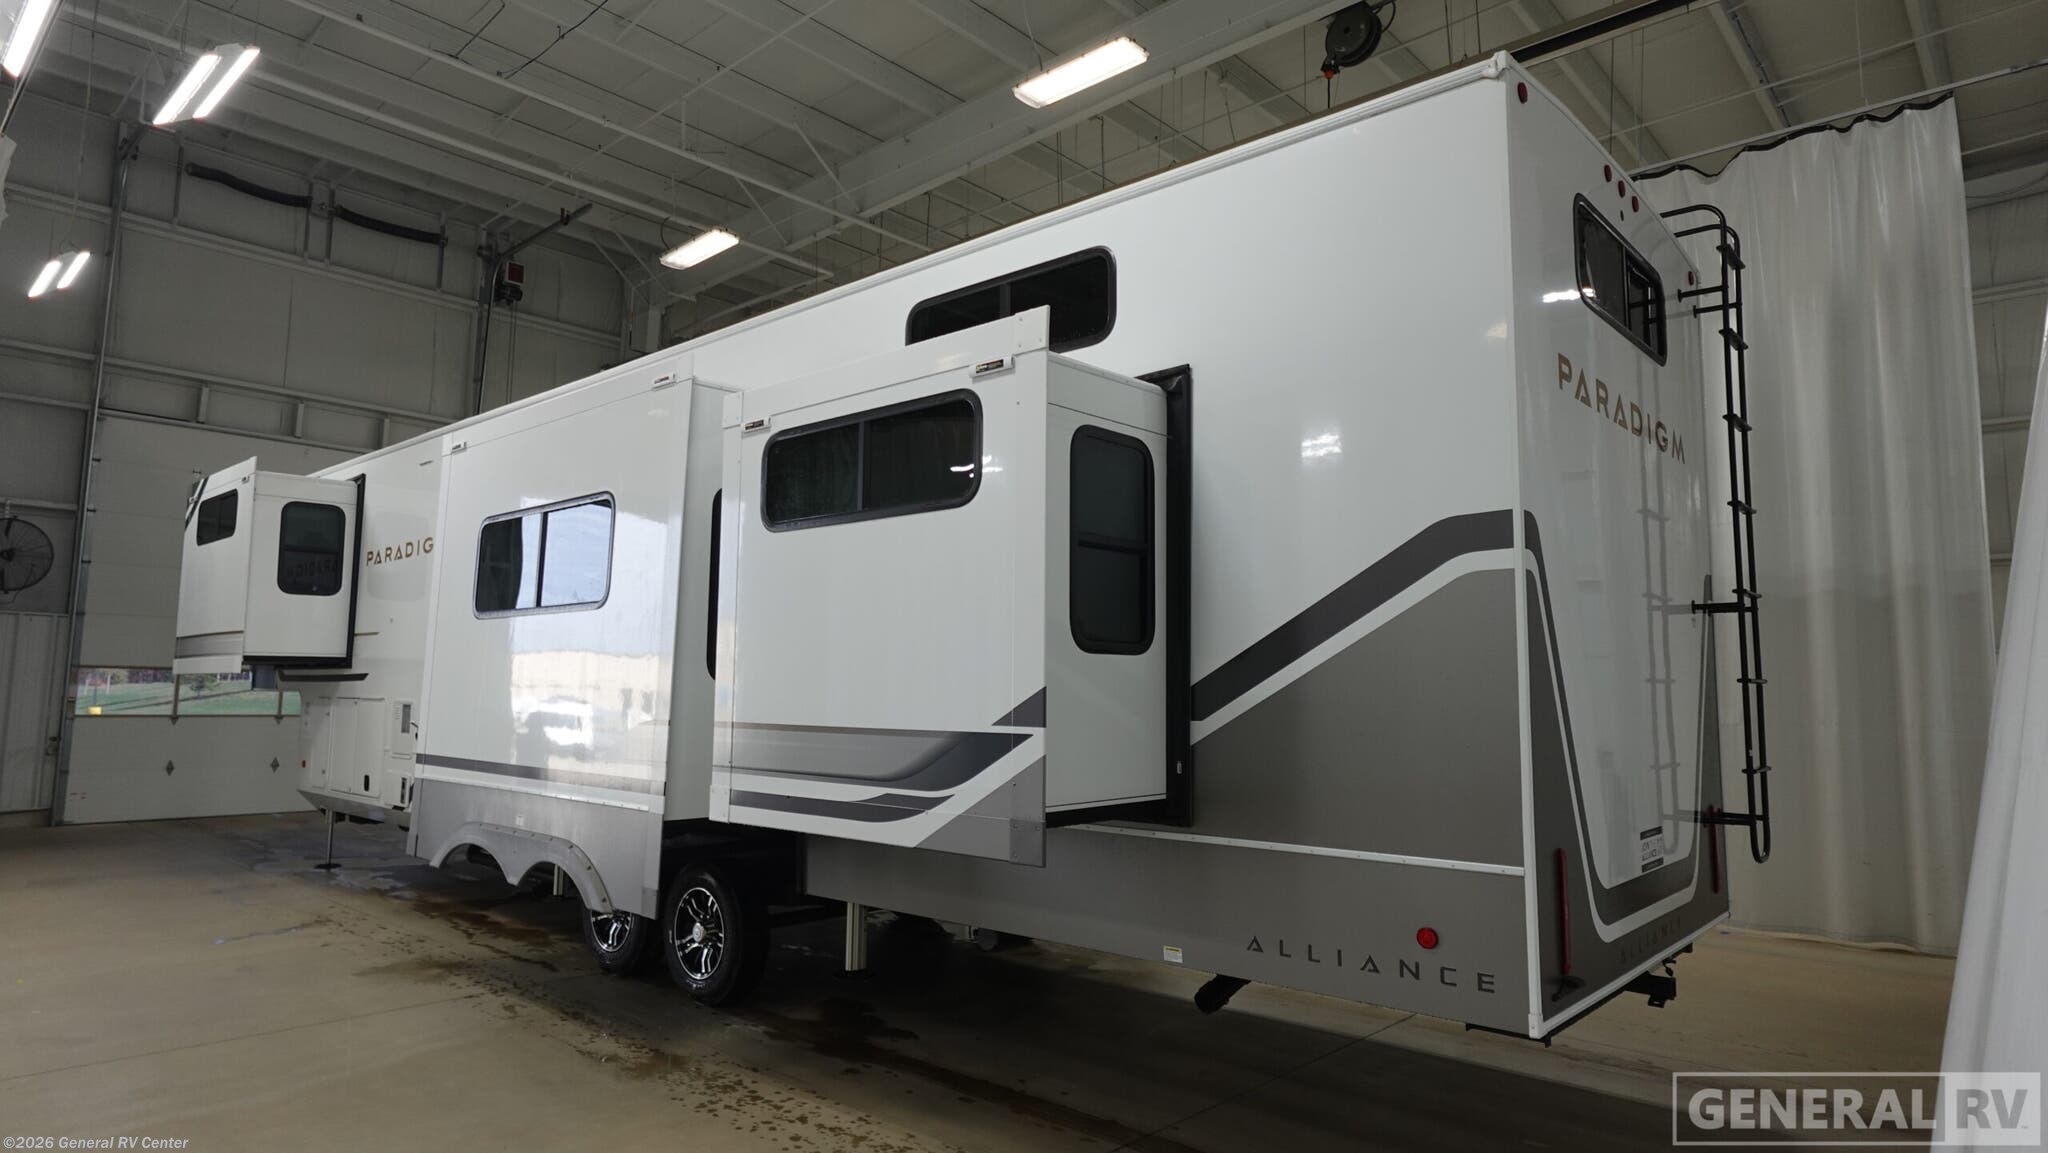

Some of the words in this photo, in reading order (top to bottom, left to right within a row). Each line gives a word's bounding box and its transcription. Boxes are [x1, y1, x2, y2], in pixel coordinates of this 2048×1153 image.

[1557, 352, 1686, 465] PARADIGM
[366, 536, 433, 567] PARADIG
[1245, 935, 1496, 995] ALLIANCE
